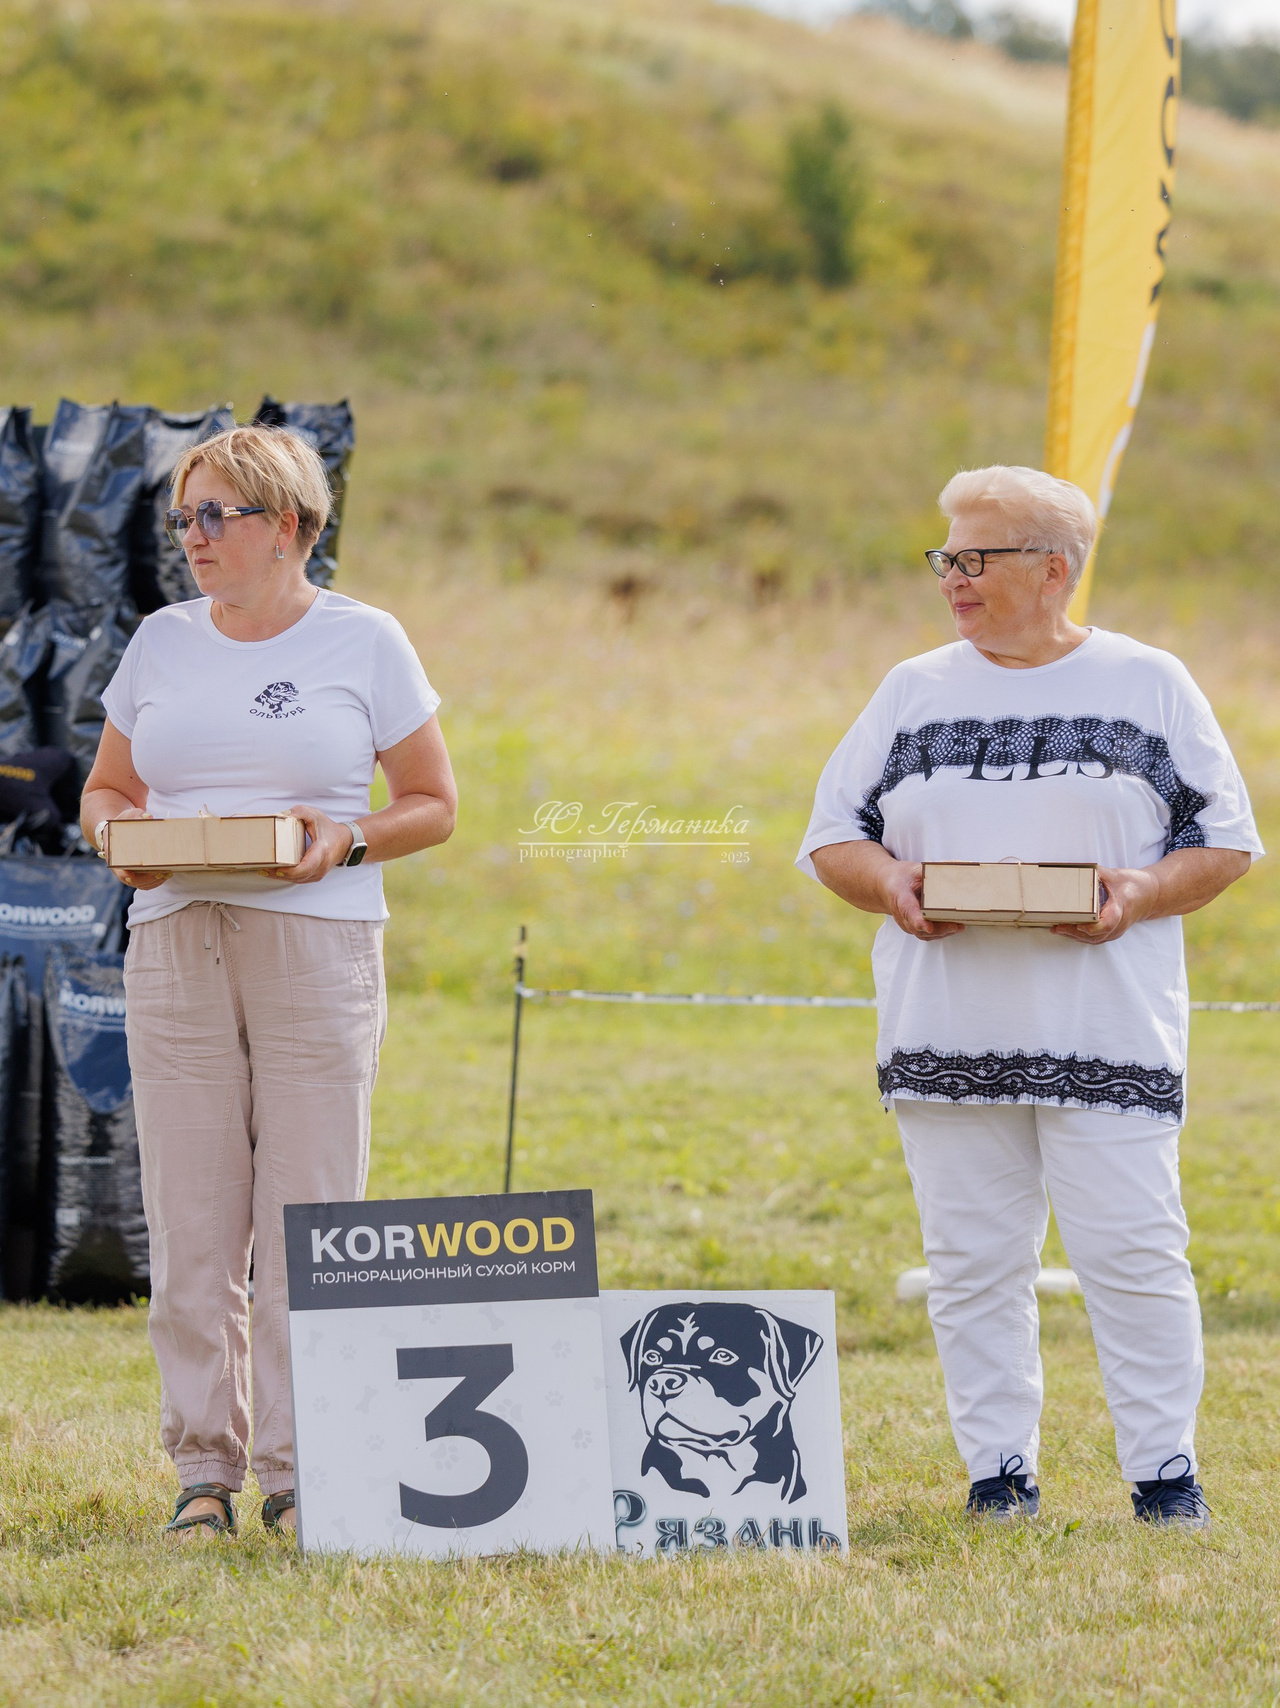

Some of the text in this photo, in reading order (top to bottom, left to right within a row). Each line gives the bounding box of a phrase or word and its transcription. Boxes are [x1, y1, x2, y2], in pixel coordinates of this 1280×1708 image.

[249, 706, 306, 719] ОЛЬБУРД
[310, 1216, 576, 1263] KORWOOD
[312, 1260, 576, 1284] ПОЛНОРАЦИОННЫЙ СУХОЙ КОРМ
[396, 1343, 529, 1528] 3
